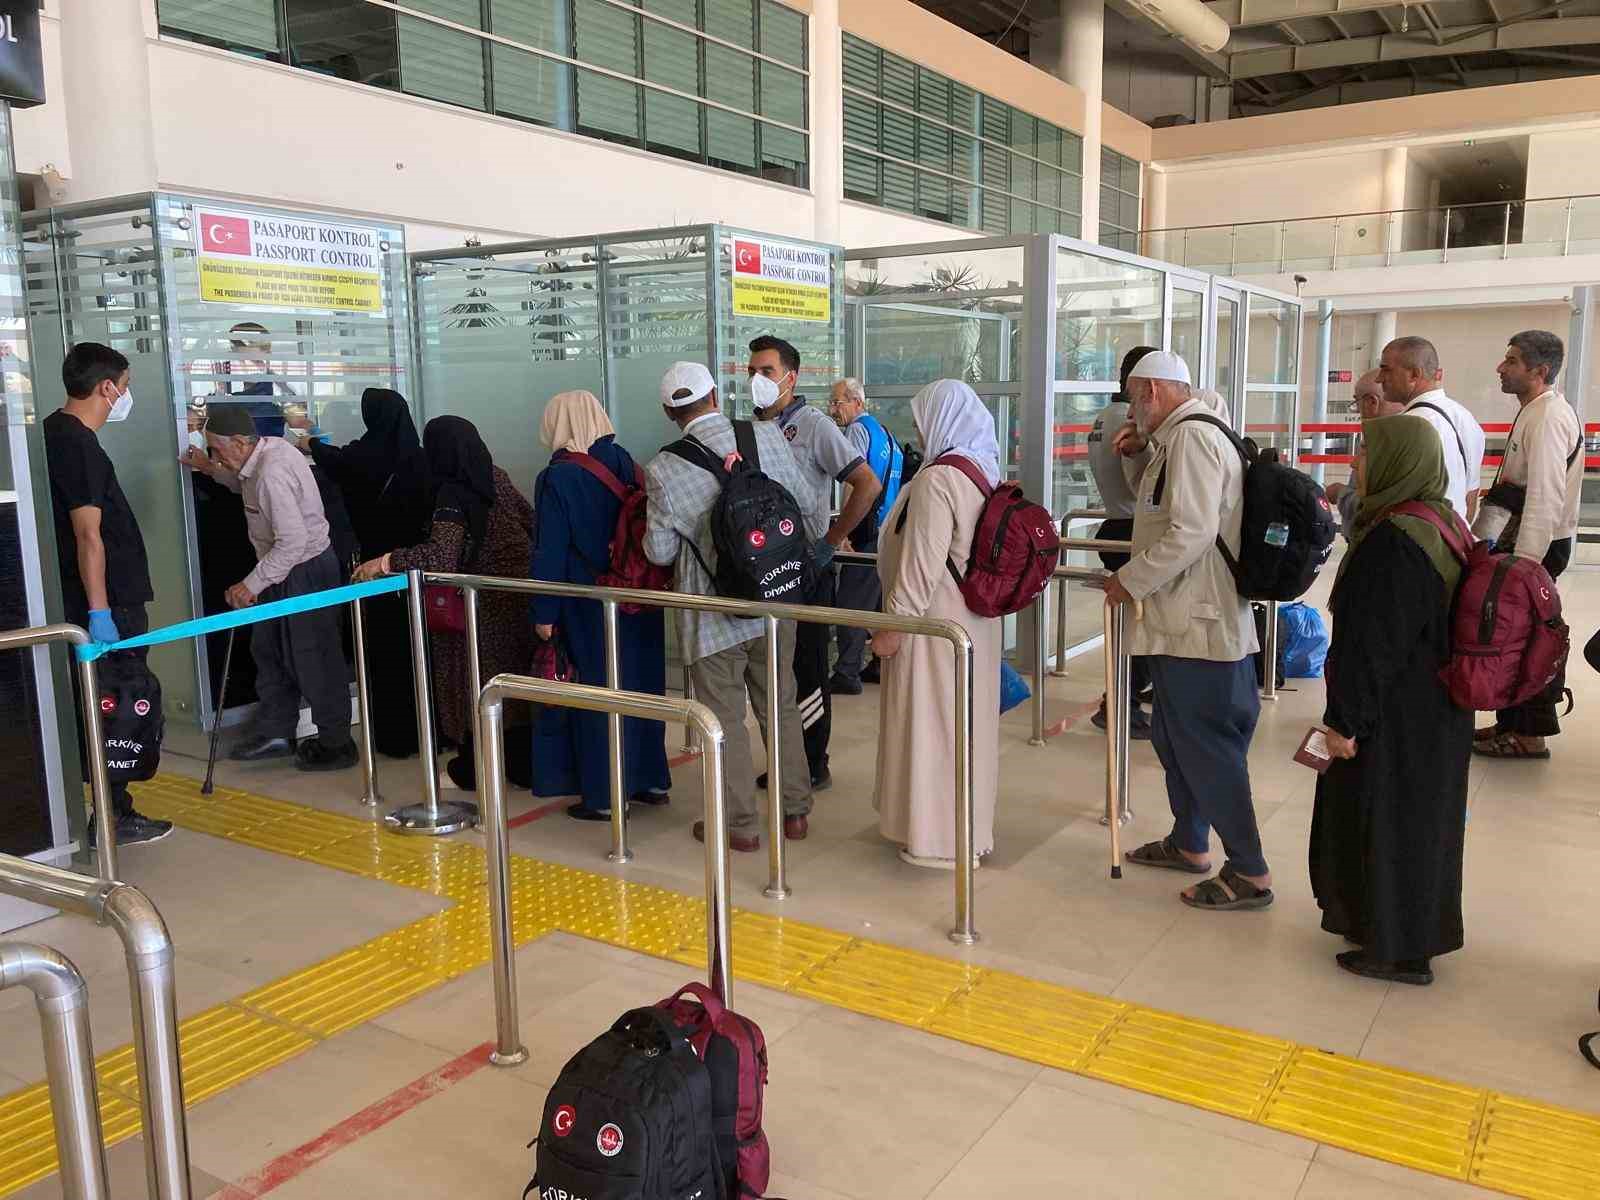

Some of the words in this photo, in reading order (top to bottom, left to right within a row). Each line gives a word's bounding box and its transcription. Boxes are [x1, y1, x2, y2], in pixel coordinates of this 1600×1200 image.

[254, 220, 316, 242] PASAPORT
[319, 228, 375, 248] KONTROL
[255, 243, 316, 264] PASSPORT
[320, 249, 376, 268] CONTROL
[762, 244, 796, 262] PASAPORT
[797, 252, 826, 267] KONTROL
[763, 263, 796, 280] PASSPORT
[797, 270, 826, 284] CONTROL
[107, 759, 138, 769] ANET
